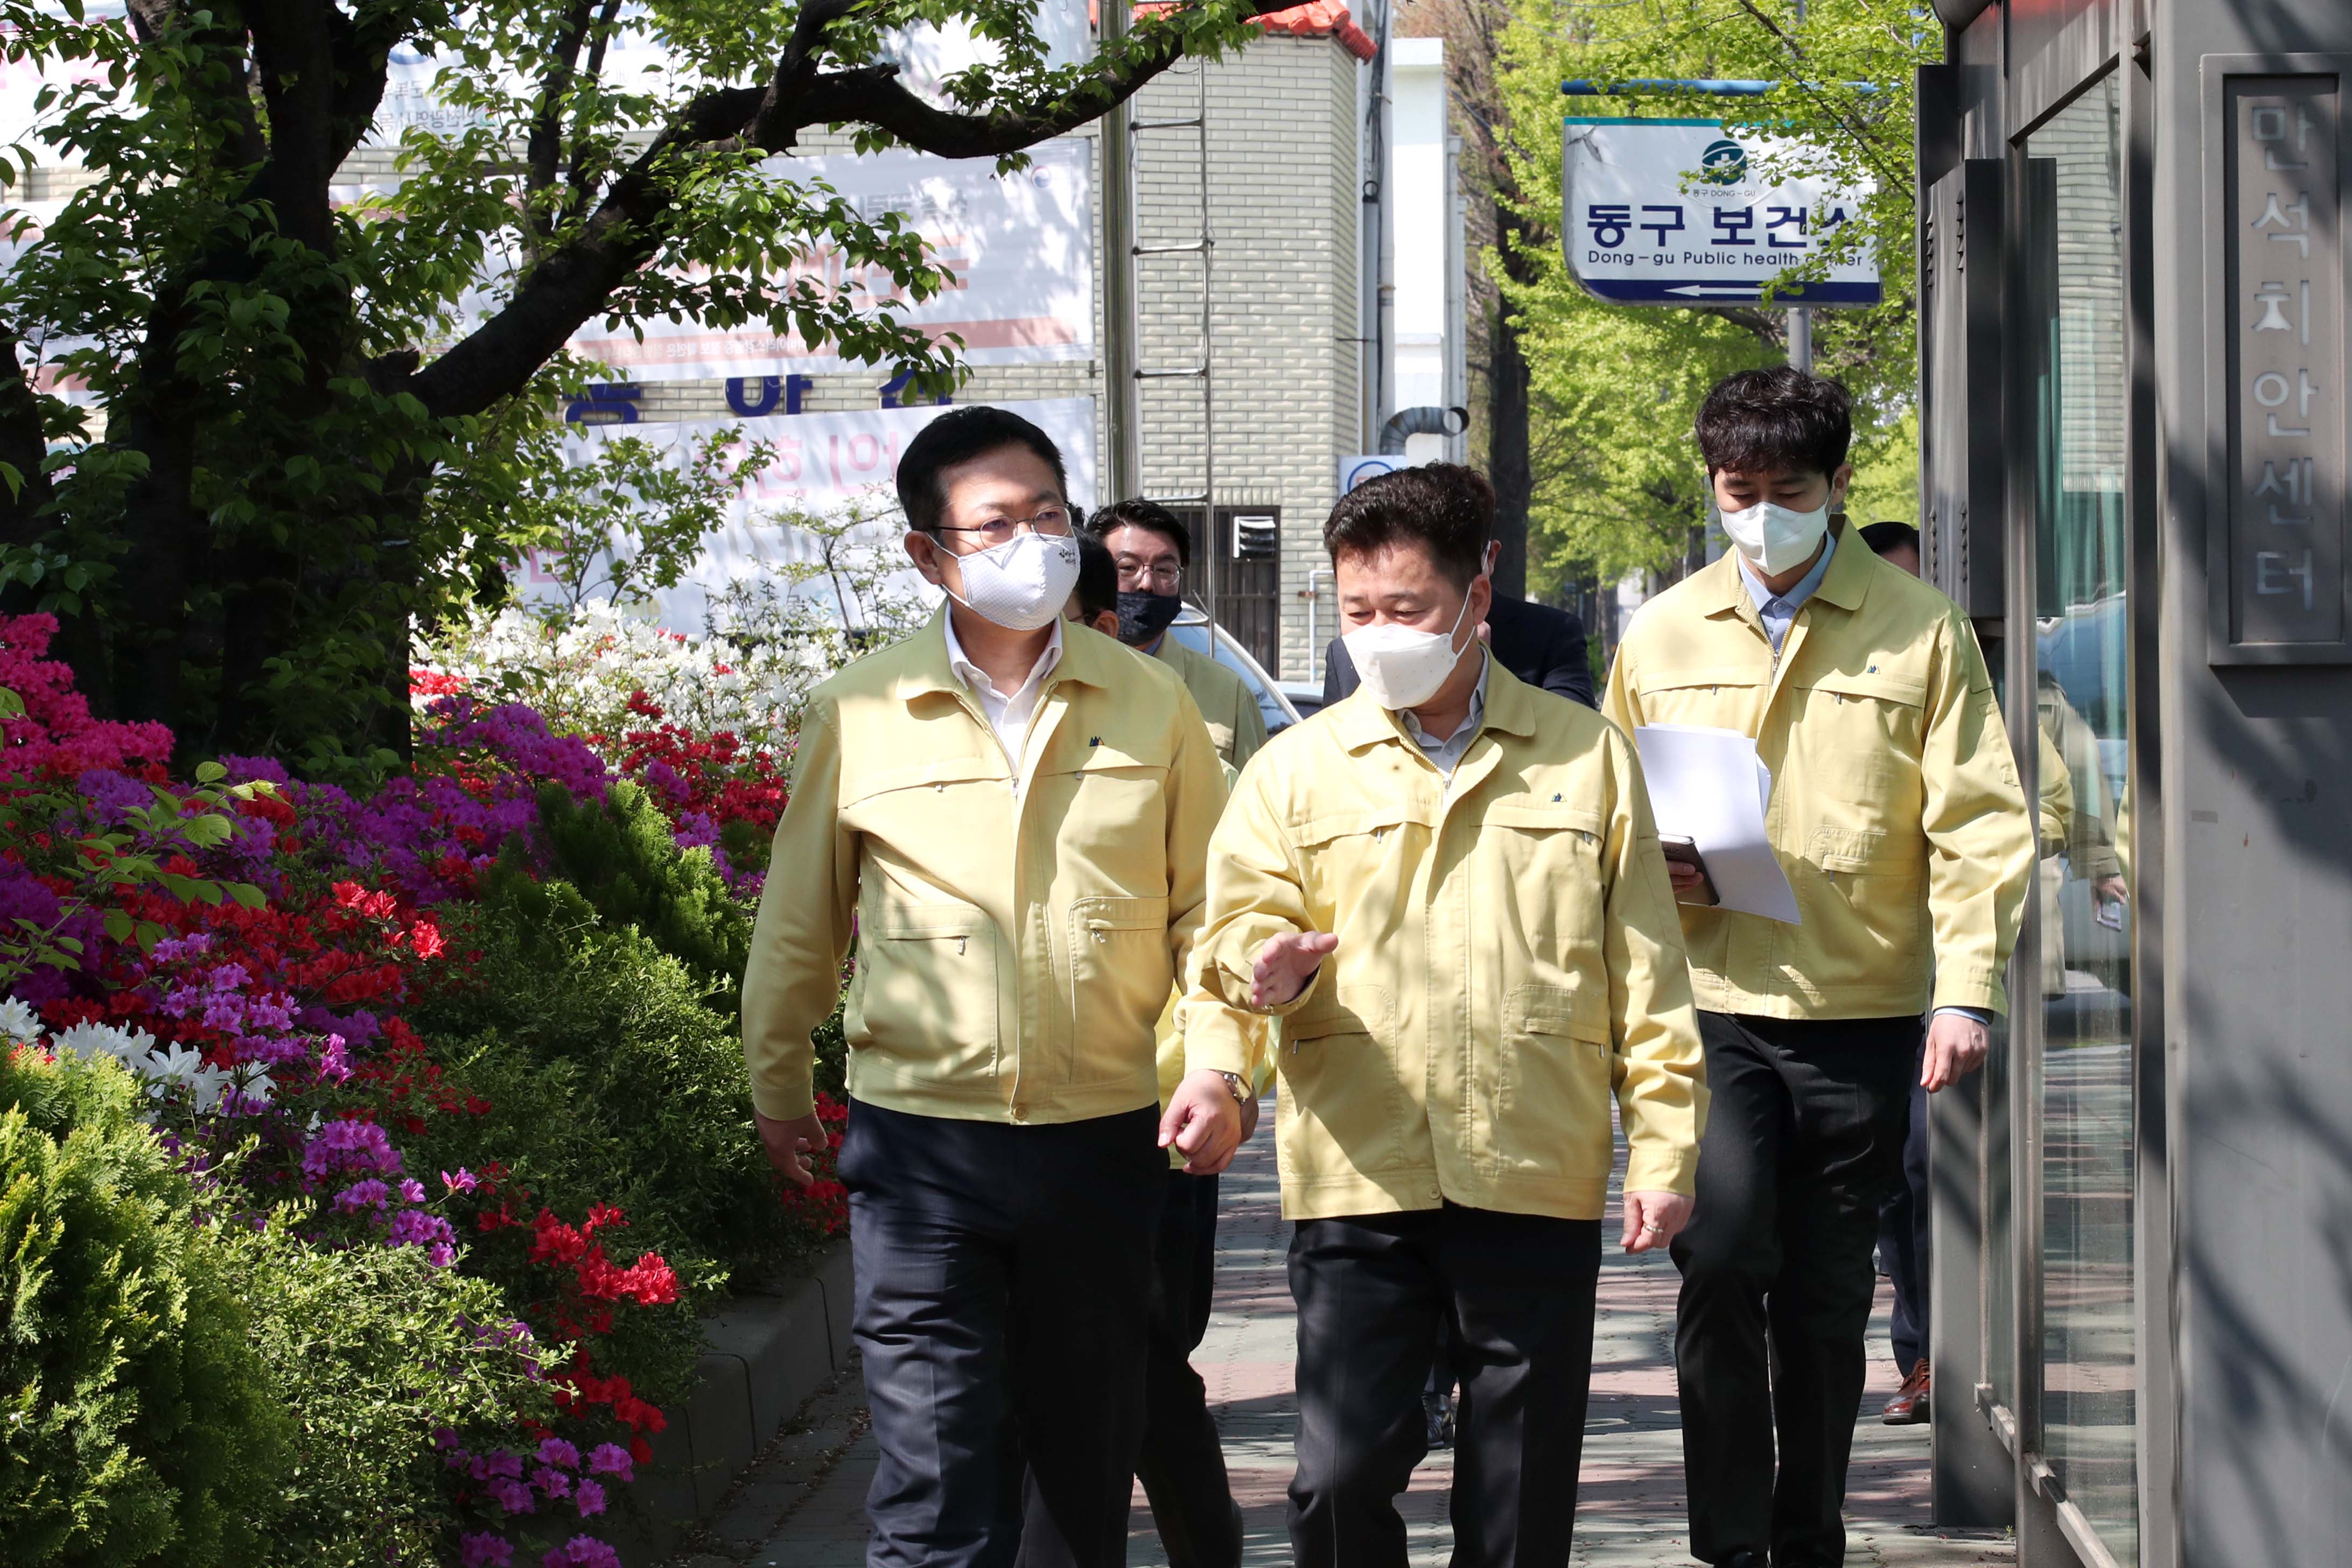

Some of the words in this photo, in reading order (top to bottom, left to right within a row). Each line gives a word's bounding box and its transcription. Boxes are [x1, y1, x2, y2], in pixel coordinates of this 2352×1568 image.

[1587, 205, 1685, 248] 동구
[1711, 206, 1864, 248] 보건소
[1683, 251, 1736, 265] Public
[1744, 251, 1798, 265] health
[2251, 101, 2320, 613] 만석치안센터
